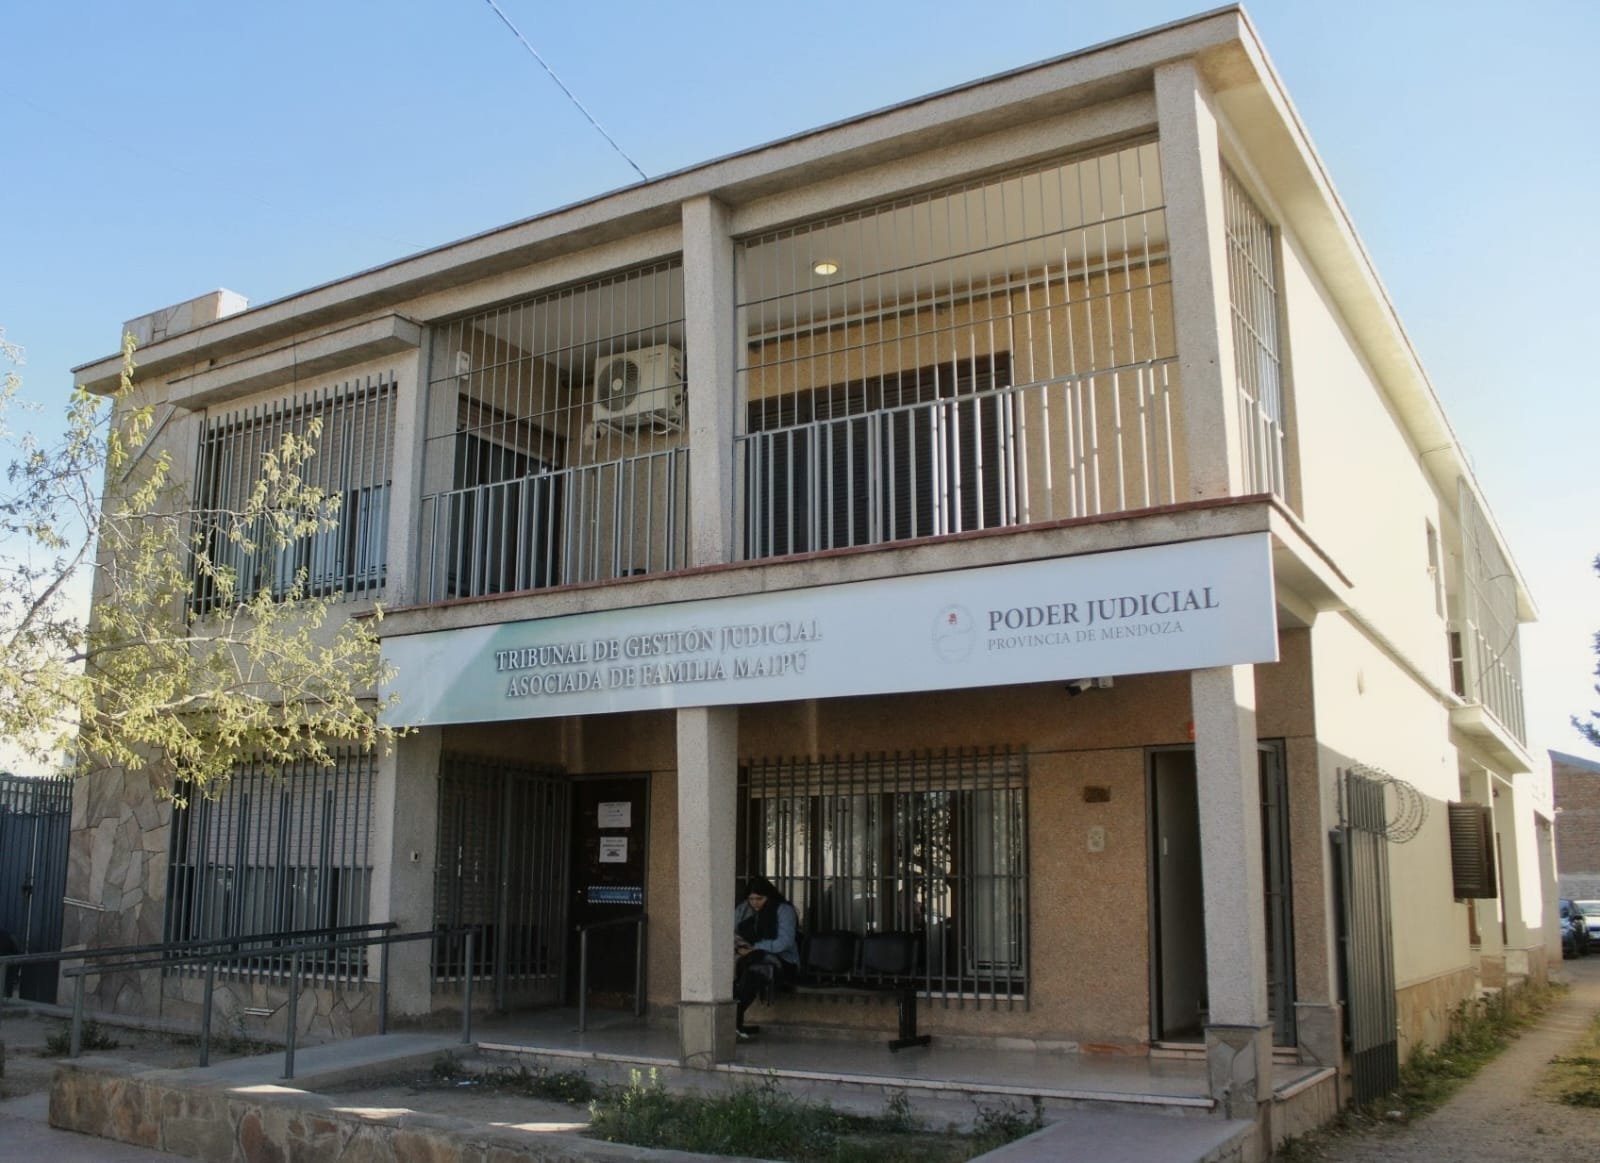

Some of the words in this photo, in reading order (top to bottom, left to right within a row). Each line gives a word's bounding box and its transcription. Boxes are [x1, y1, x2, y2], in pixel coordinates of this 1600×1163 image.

[988, 603, 1079, 631] PODER
[1087, 587, 1220, 625] JUDICIAL
[496, 645, 588, 671] TRIBUNAL
[592, 640, 619, 661] DE
[625, 626, 713, 657] GESTIÓN
[720, 619, 823, 650] JUDICIAL
[988, 633, 1072, 651] PROVINCIA
[1076, 630, 1097, 643] DE
[1101, 621, 1184, 640] MENDOZA
[506, 670, 602, 697] ASOCIADA
[608, 666, 636, 689] DE
[642, 659, 727, 685] FAMILIA
[734, 649, 806, 679] MAIPÚ
